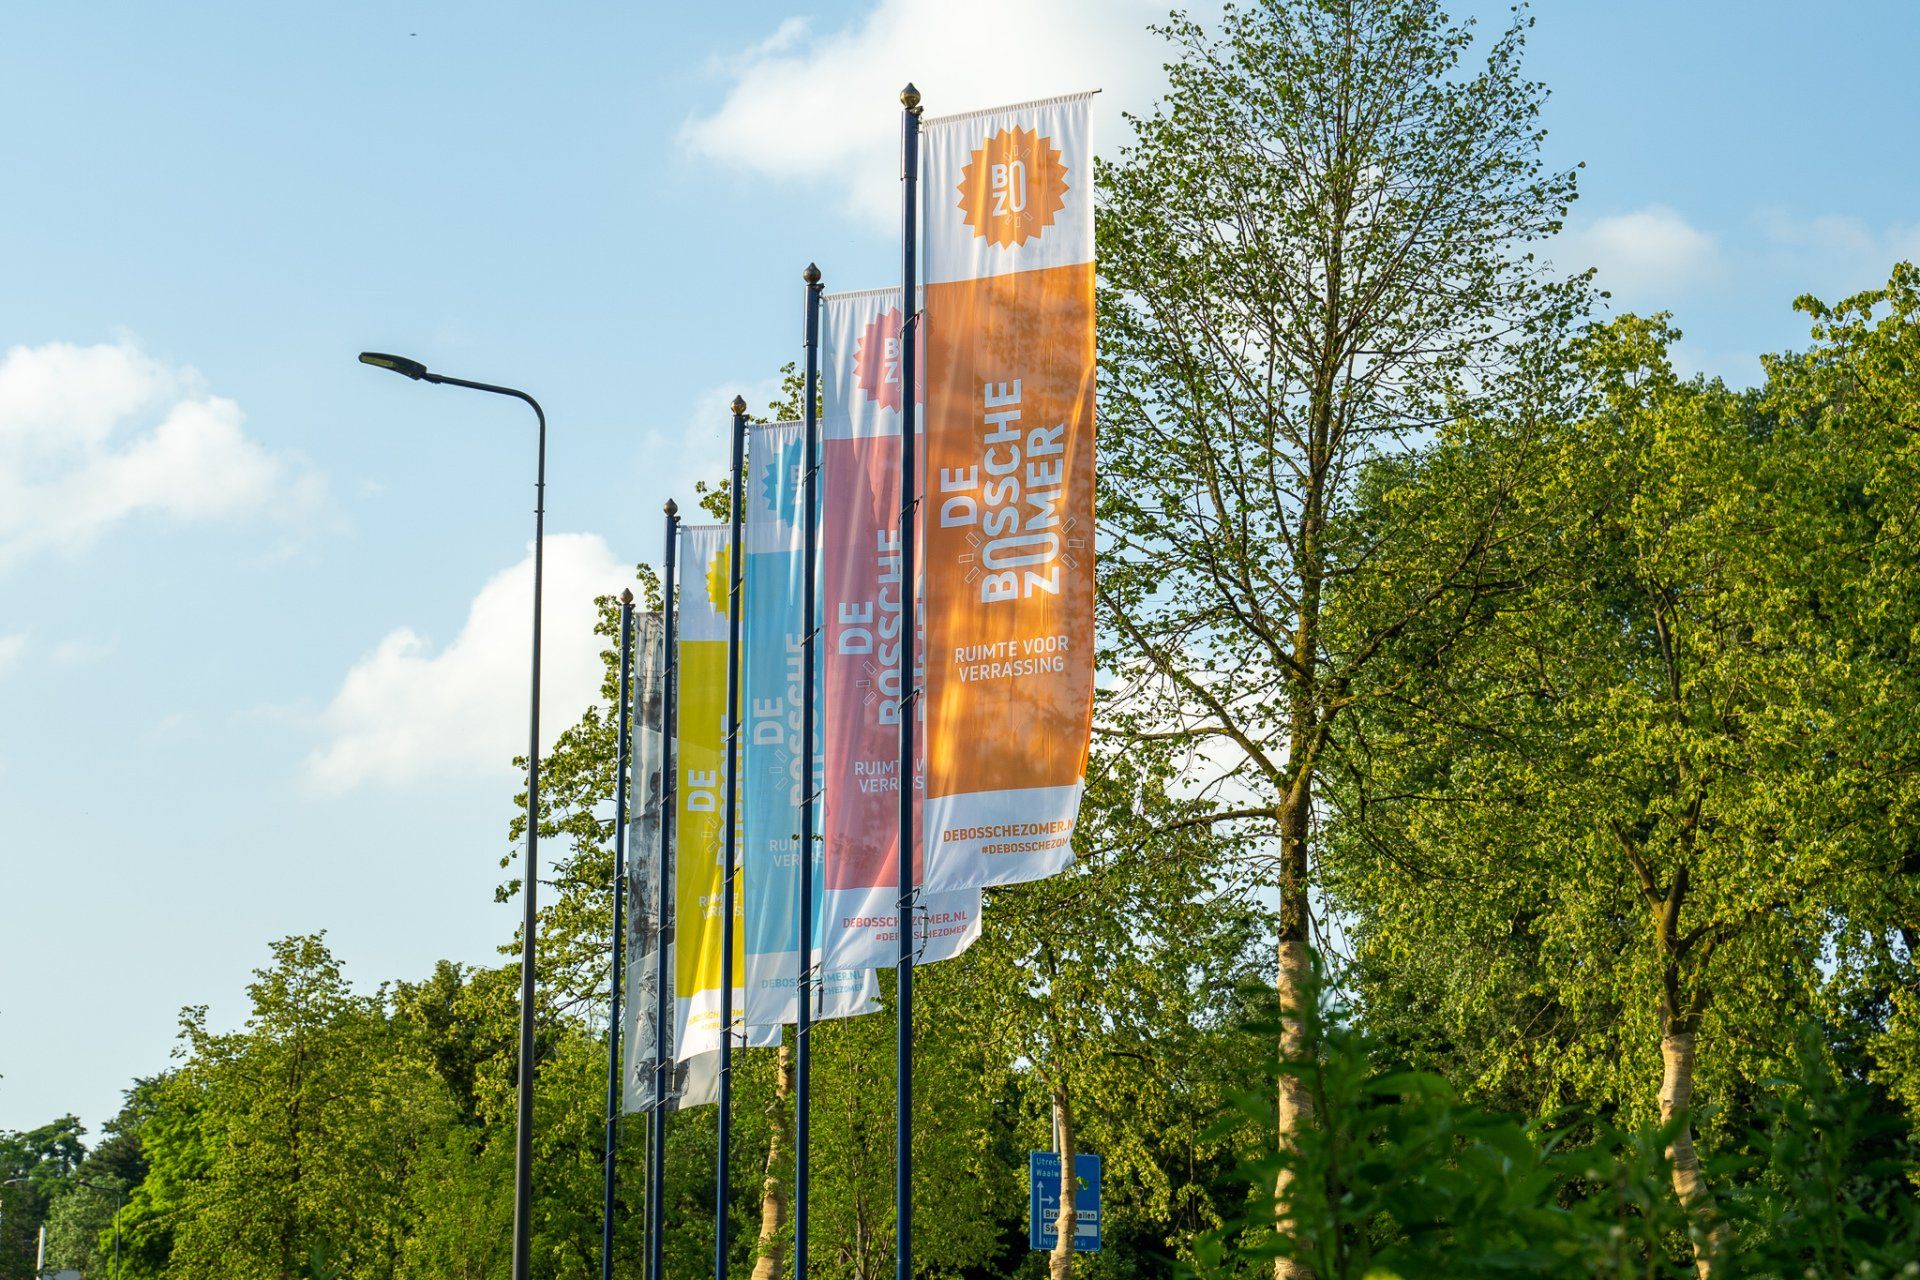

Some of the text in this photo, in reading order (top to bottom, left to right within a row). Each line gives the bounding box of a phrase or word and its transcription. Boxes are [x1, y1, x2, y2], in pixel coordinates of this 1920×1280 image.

[941, 465, 978, 528] DE
[981, 378, 1022, 603] BOSSCHE
[1024, 423, 1064, 598] ZOMER
[838, 600, 874, 655] DE
[955, 635, 1069, 663] RUIMTE VOOR
[959, 655, 1064, 682] VERRASSING
[753, 696, 784, 745] DE
[855, 760, 901, 775] RUIMT
[687, 769, 716, 811] DE
[943, 818, 1074, 843] DEBOSSCHEZOMER.N
[981, 836, 1069, 855] #DEBOSSCHEZOM
[842, 911, 968, 928] DEBOSSCHZOMER.NL
[1036, 1157, 1061, 1166] Utrec
[1036, 1169, 1060, 1177] Waalw
